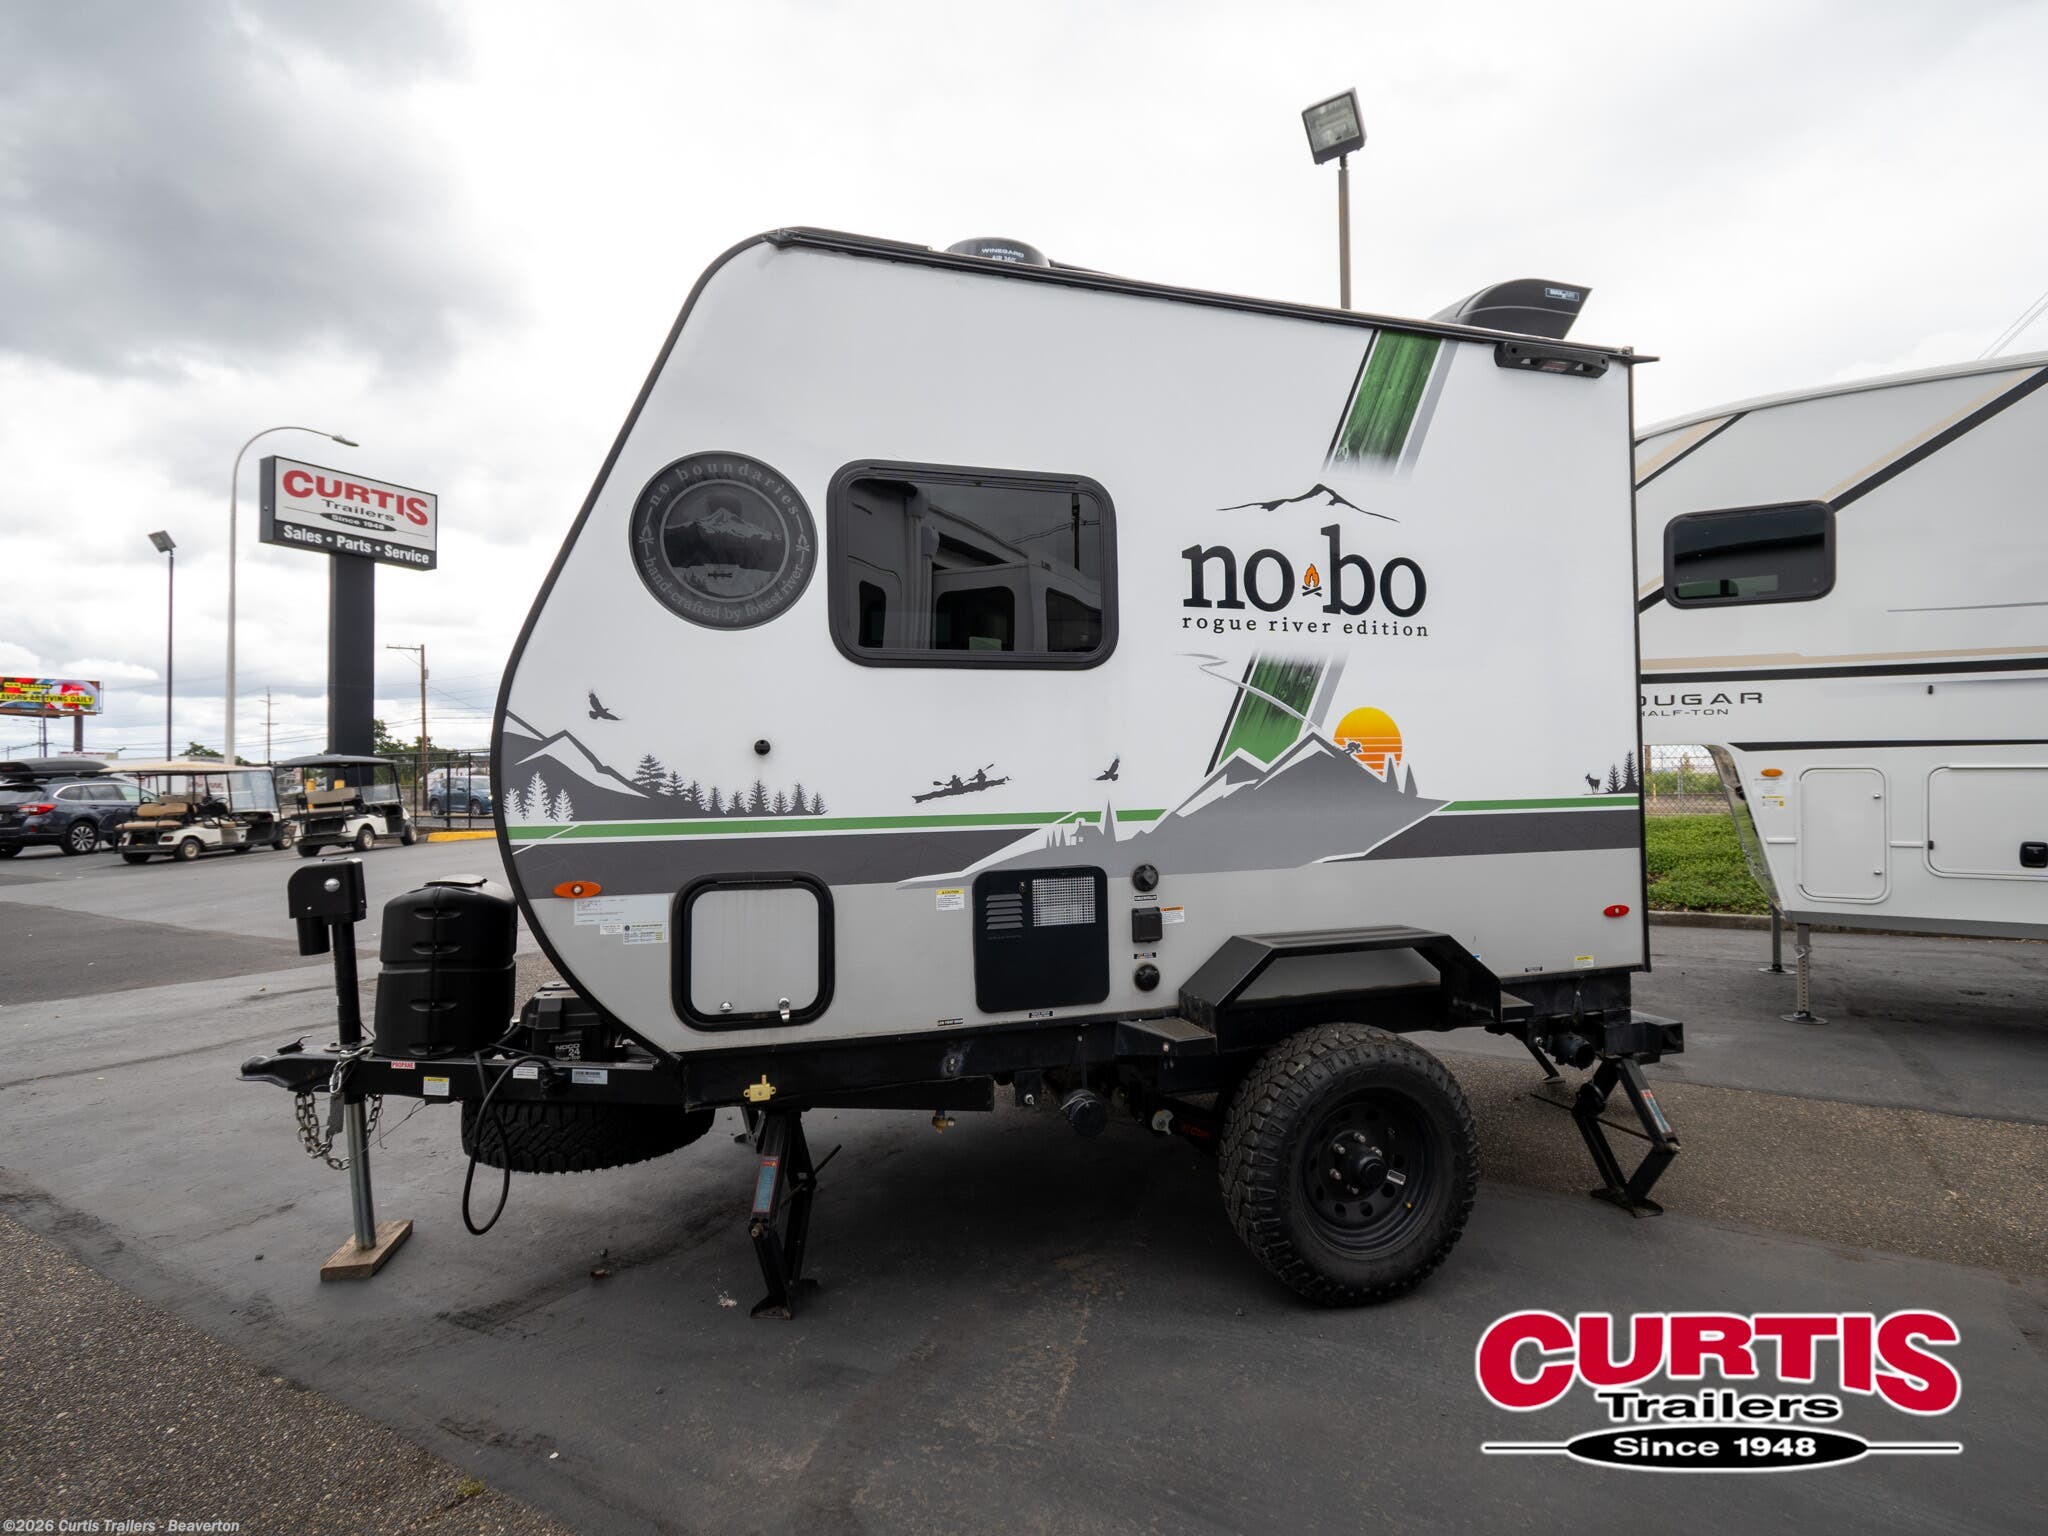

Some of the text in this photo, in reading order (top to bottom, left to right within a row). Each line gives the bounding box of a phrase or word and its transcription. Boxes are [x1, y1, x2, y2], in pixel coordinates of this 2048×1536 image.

[282, 469, 428, 526] CURTIS
[650, 463, 799, 516] no boundaries
[321, 498, 395, 522] Trailers
[331, 514, 385, 530] Since 1948
[283, 524, 429, 564] Sales Parts Service
[724, 609, 742, 623] by
[745, 591, 783, 617] forest
[1182, 616, 1428, 637] rogue river edition
[70, 695, 93, 703] DAILY
[1641, 692, 1763, 706] UGAR
